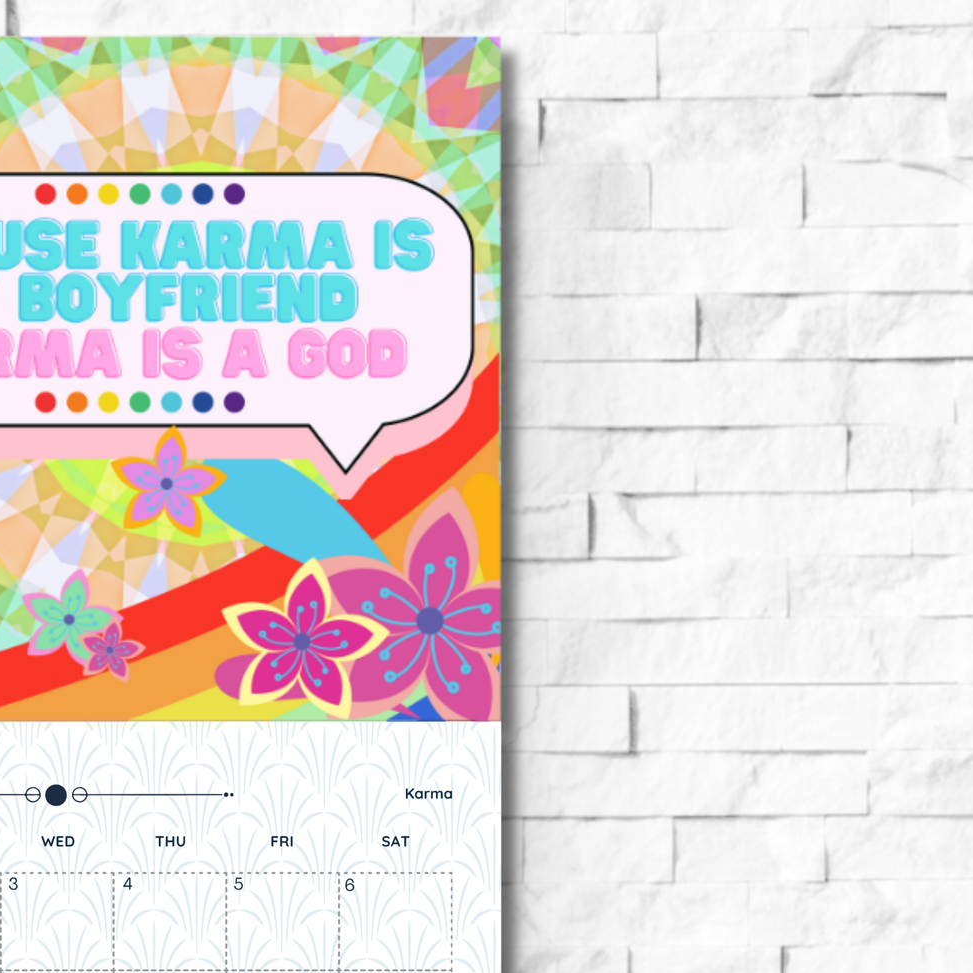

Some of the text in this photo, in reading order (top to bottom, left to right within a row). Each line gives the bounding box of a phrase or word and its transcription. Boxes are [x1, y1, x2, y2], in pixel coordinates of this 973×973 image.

[120, 219, 353, 270] KARMA
[373, 217, 435, 272] IS
[18, 272, 359, 323] BOYFRIEND
[142, 327, 203, 380] IS
[221, 329, 268, 378] A
[287, 328, 407, 379] GOD
[405, 787, 453, 800] Karma
[40, 835, 75, 848] WED
[155, 835, 186, 848] THU
[270, 835, 294, 848] FRI
[381, 835, 410, 848] SAT
[8, 876, 19, 891] 3
[122, 876, 133, 891] 4
[233, 876, 244, 891] 5
[344, 877, 355, 892] 6
